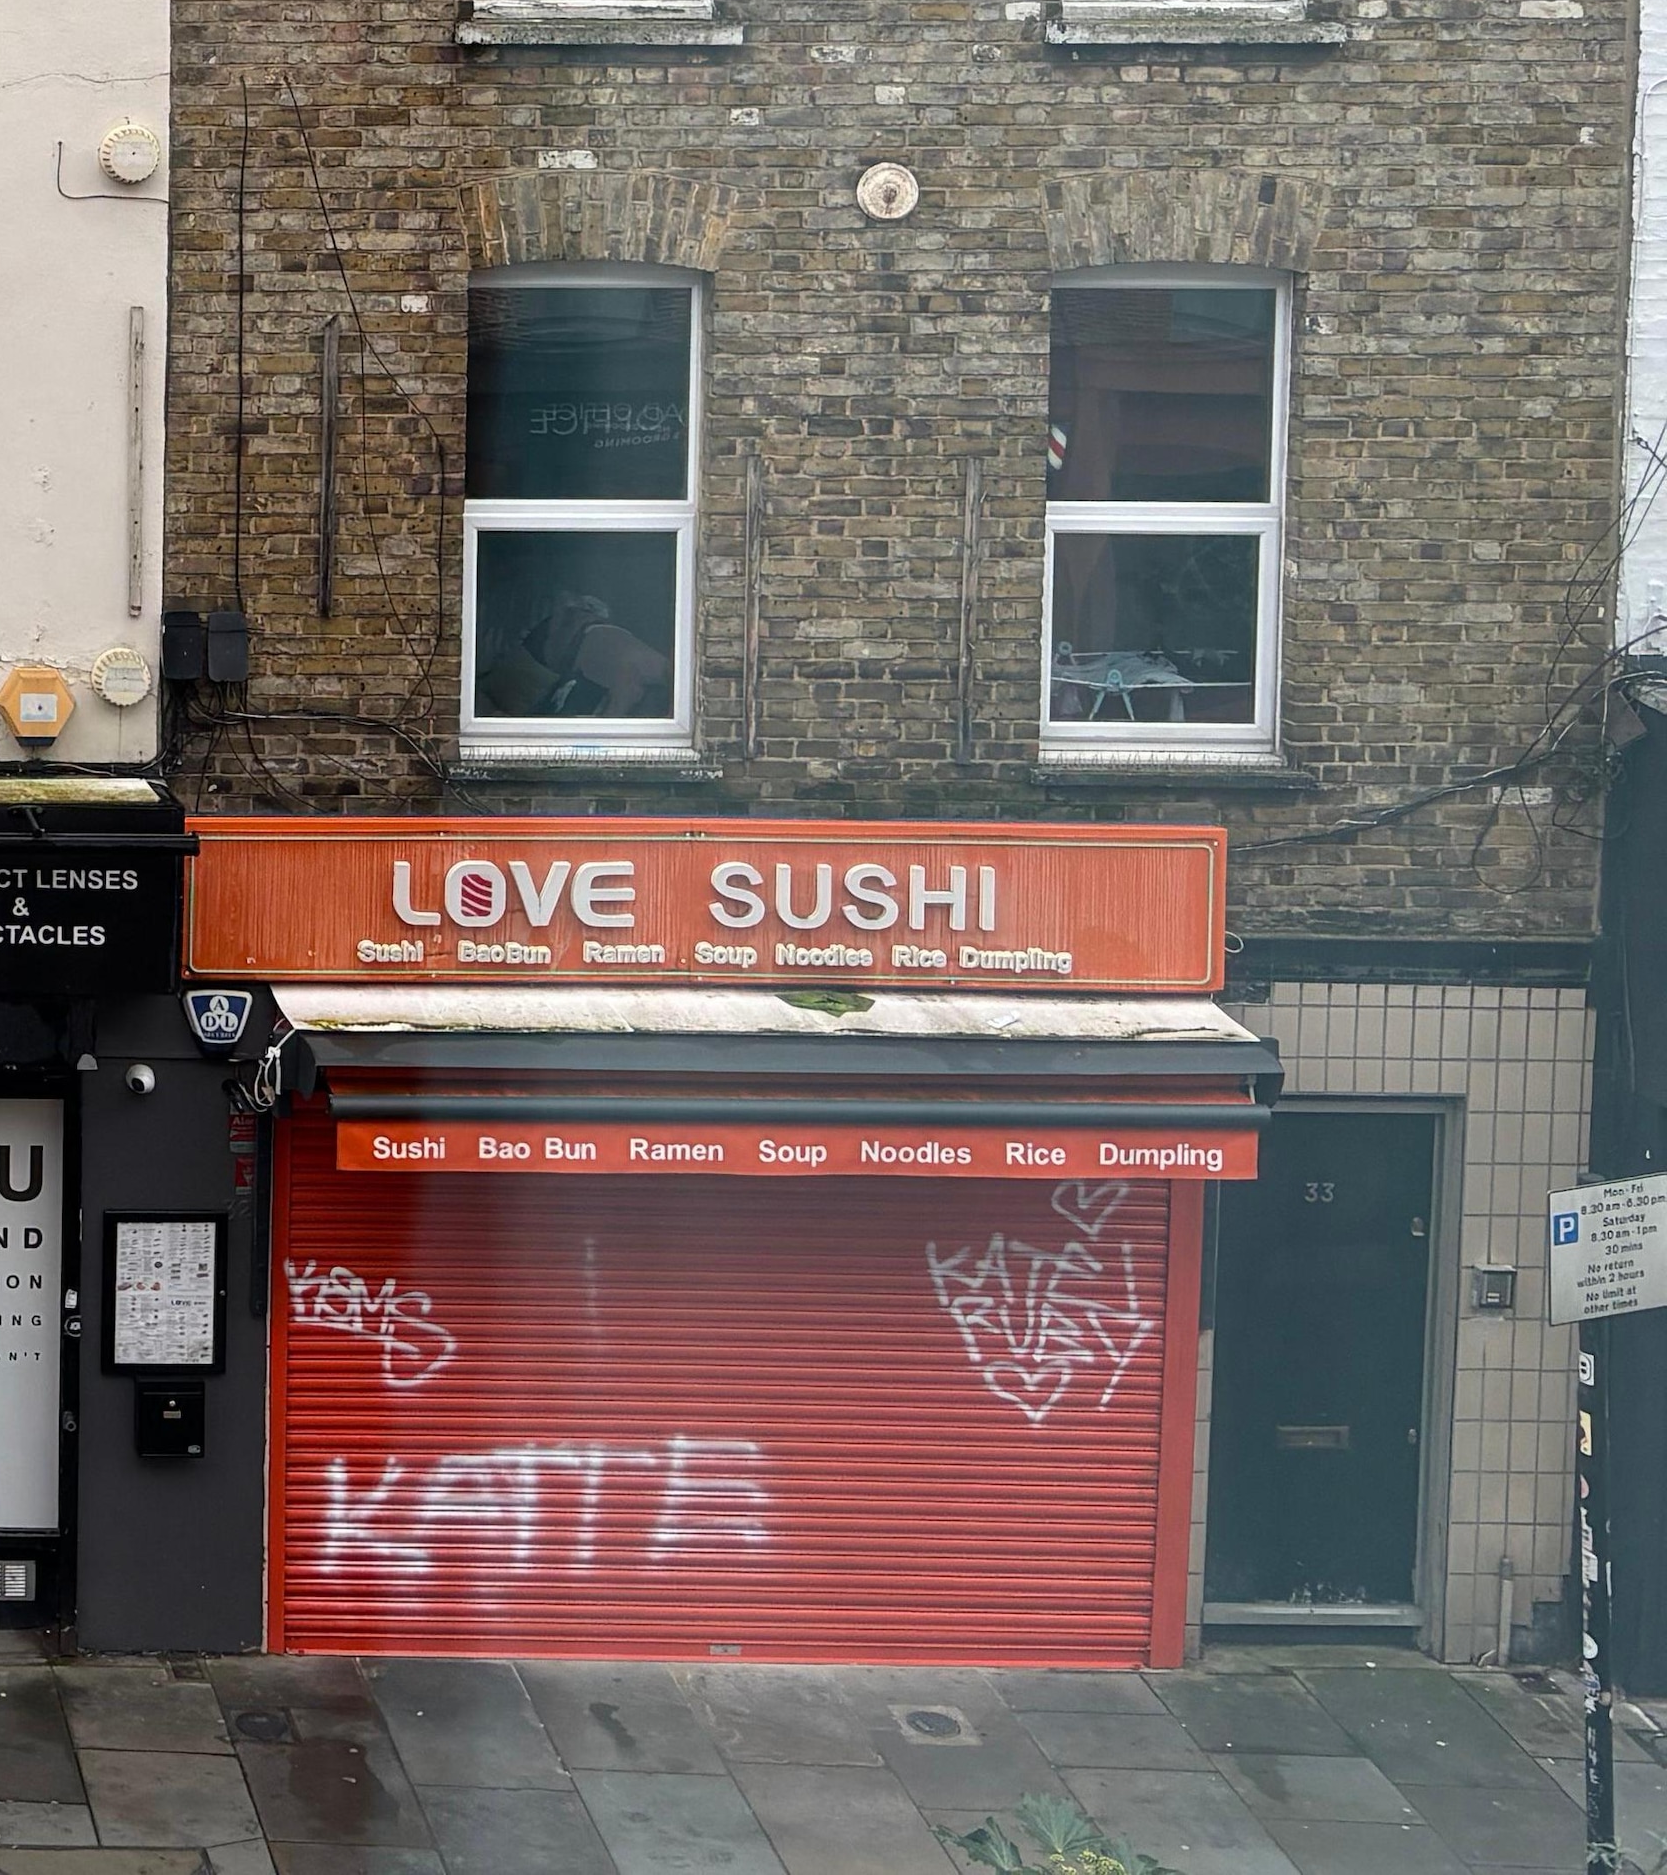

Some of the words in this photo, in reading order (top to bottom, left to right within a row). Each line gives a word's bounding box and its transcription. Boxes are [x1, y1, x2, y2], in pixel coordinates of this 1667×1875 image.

[36, 869, 139, 890] LENSES
[392, 860, 635, 928] LOVE
[709, 861, 997, 932] SUSHI
[12, 897, 30, 916] &
[356, 940, 424, 964] Sushi
[582, 941, 666, 964] Ramen
[694, 941, 757, 968] Soup
[775, 942, 874, 967] Noodles
[891, 944, 947, 968] Rice
[959, 945, 1072, 974] Dumpling
[372, 1136, 446, 1159] Sushi
[478, 1137, 531, 1160] Bao
[545, 1137, 597, 1160] Bun
[630, 1138, 724, 1161] Ramen
[758, 1140, 827, 1167] Soup
[861, 1141, 972, 1164] Noodles
[1006, 1142, 1067, 1165] Rice
[1099, 1142, 1223, 1171] Dumpling
[1305, 1183, 1335, 1203] 33
[1560, 1216, 1575, 1242] P
[1603, 1212, 1646, 1227] Saturday
[1605, 1244, 1619, 1256] 30
[1621, 1241, 1643, 1253] mins
[1588, 1263, 1601, 1274] No
[1604, 1259, 1634, 1271] return
[1577, 1275, 1606, 1288] within
[1618, 1269, 1645, 1281] hours
[1586, 1291, 1599, 1302] No
[1603, 1287, 1624, 1300] limit
[1627, 1285, 1637, 1295] at
[1584, 1303, 1609, 1314] other
[1612, 1298, 1638, 1310] times
